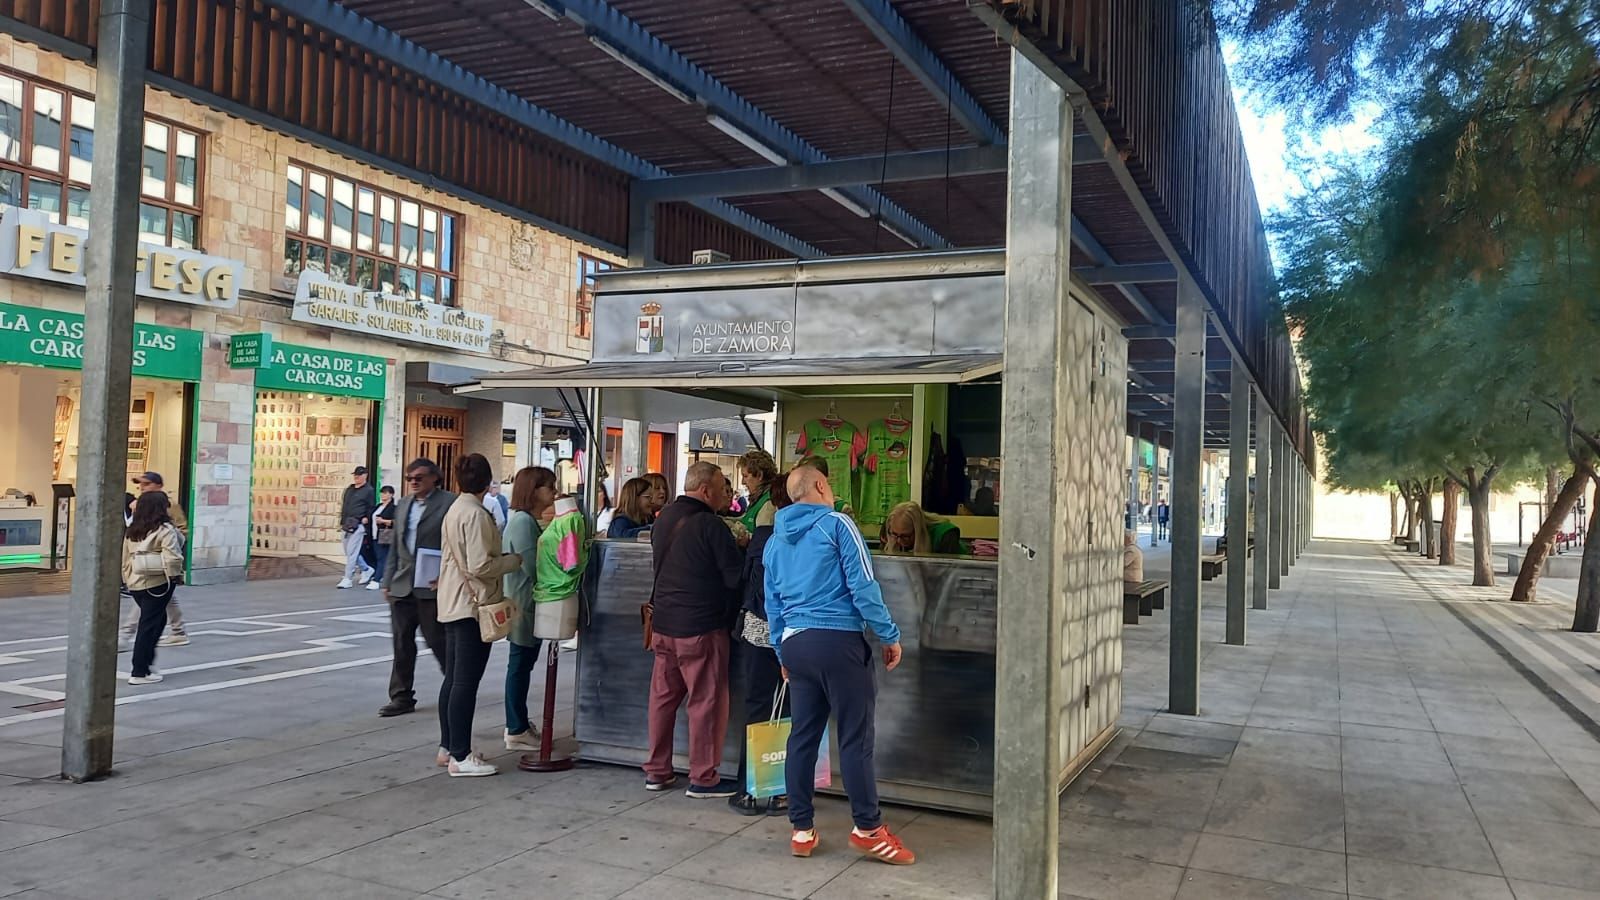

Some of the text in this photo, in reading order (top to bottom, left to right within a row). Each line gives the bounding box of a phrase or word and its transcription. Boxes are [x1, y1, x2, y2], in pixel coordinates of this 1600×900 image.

[308, 282, 347, 304] VENTA
[354, 292, 369, 308] DE
[374, 295, 429, 320] VIVIENDAS
[308, 303, 358, 324] GARAJES
[367, 313, 412, 334] SOLARES
[693, 320, 793, 336] AYUNTAMIENTO
[0, 311, 176, 351] LA CAS LAS
[244, 340, 258, 348] CASA
[692, 335, 792, 354] DE ZAMORA
[232, 356, 260, 364] CARCASAS
[271, 350, 383, 376] A CASA DE LAS
[285, 369, 363, 390] CARCASAS
